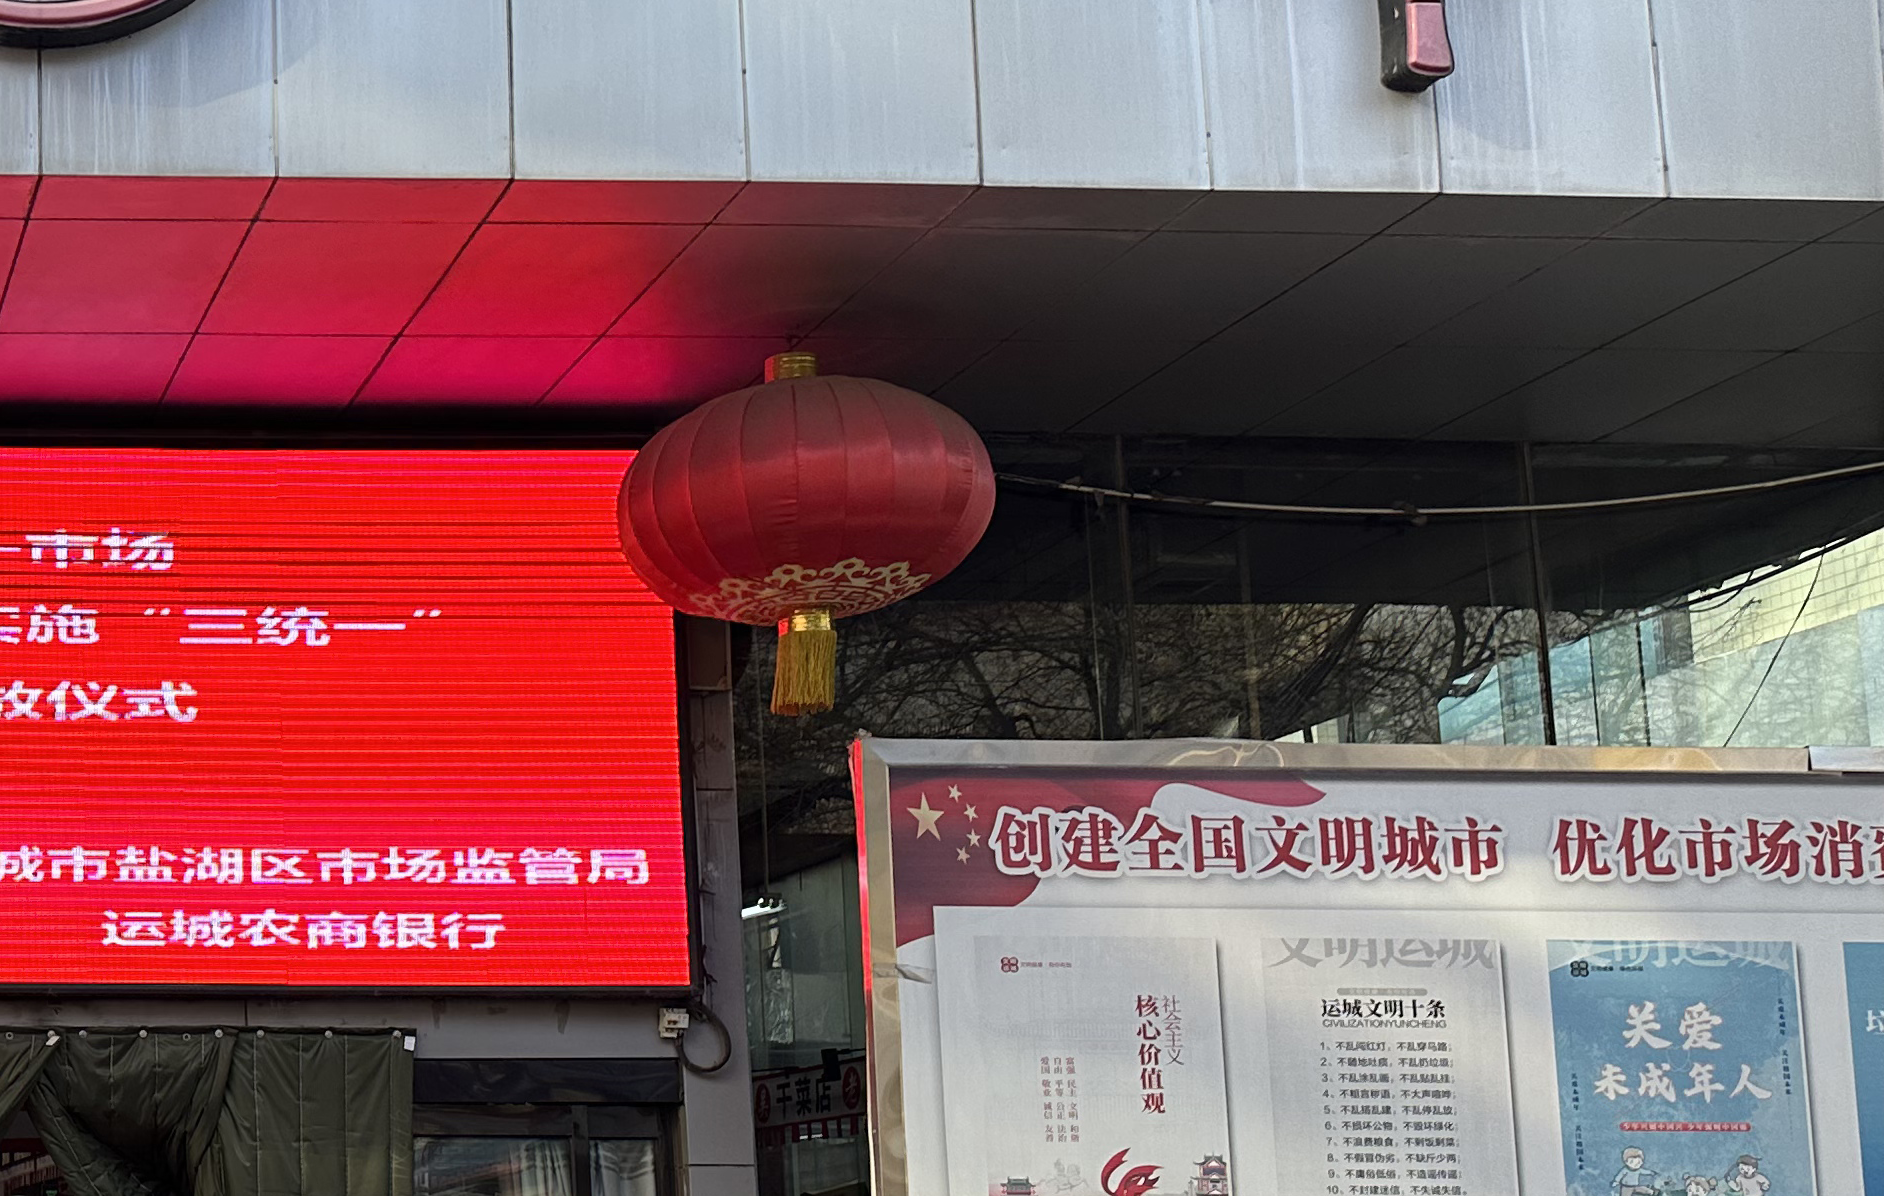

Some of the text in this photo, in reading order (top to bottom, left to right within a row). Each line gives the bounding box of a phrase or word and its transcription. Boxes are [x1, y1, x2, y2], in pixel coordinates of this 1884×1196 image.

[992, 805, 1504, 877] 创建全国文明城市
[101, 910, 506, 950] 运城农商银行
[1161, 995, 1185, 1066] 社会主义
[1321, 999, 1446, 1018] 运城文明十条
[1622, 1001, 1723, 1050] 关爱
[1135, 995, 1166, 1114] 核心价值观
[1593, 1062, 1773, 1103] 未成年人
